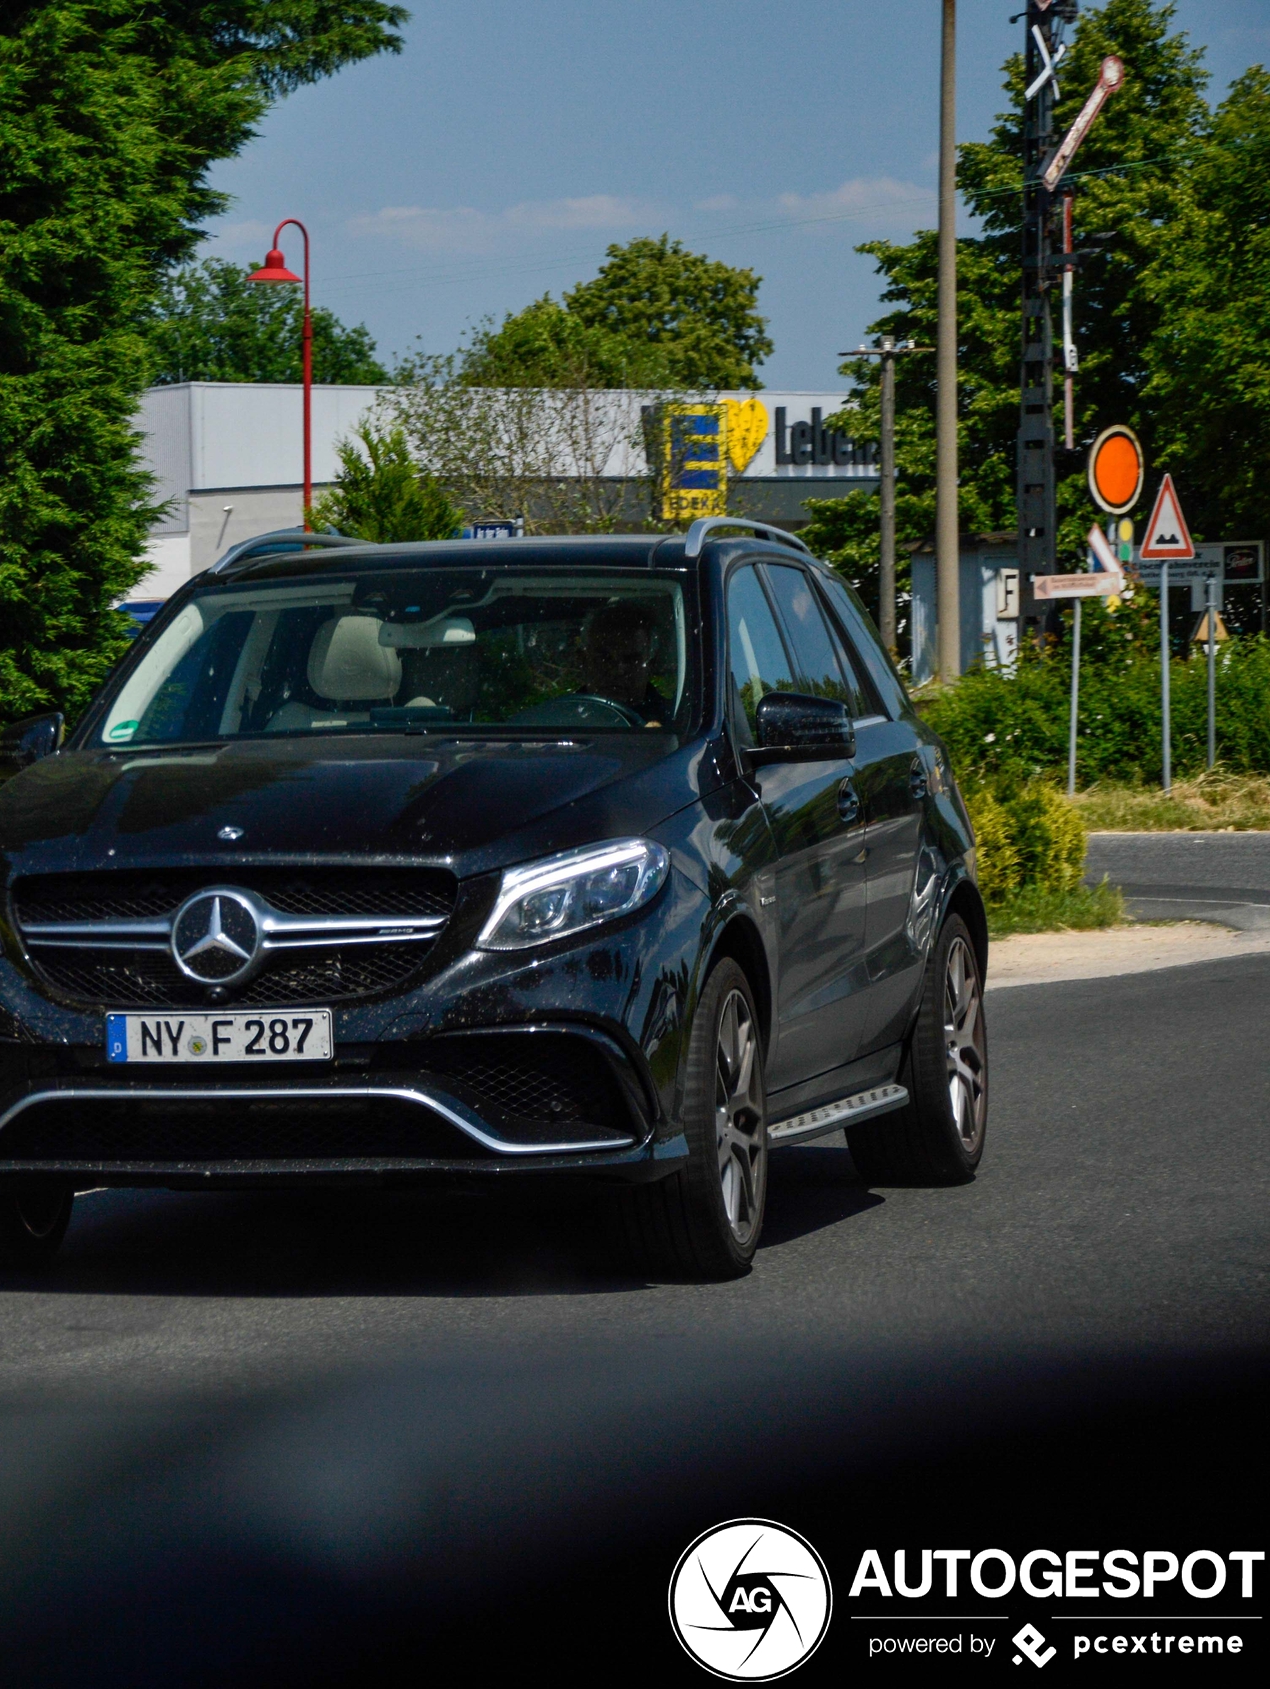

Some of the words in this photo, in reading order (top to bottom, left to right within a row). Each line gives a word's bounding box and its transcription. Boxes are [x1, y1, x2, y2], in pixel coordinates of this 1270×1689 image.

[114, 1042, 122, 1053] D
[141, 1020, 185, 1056] NY
[211, 1020, 234, 1056] F
[244, 1018, 313, 1055] 287
